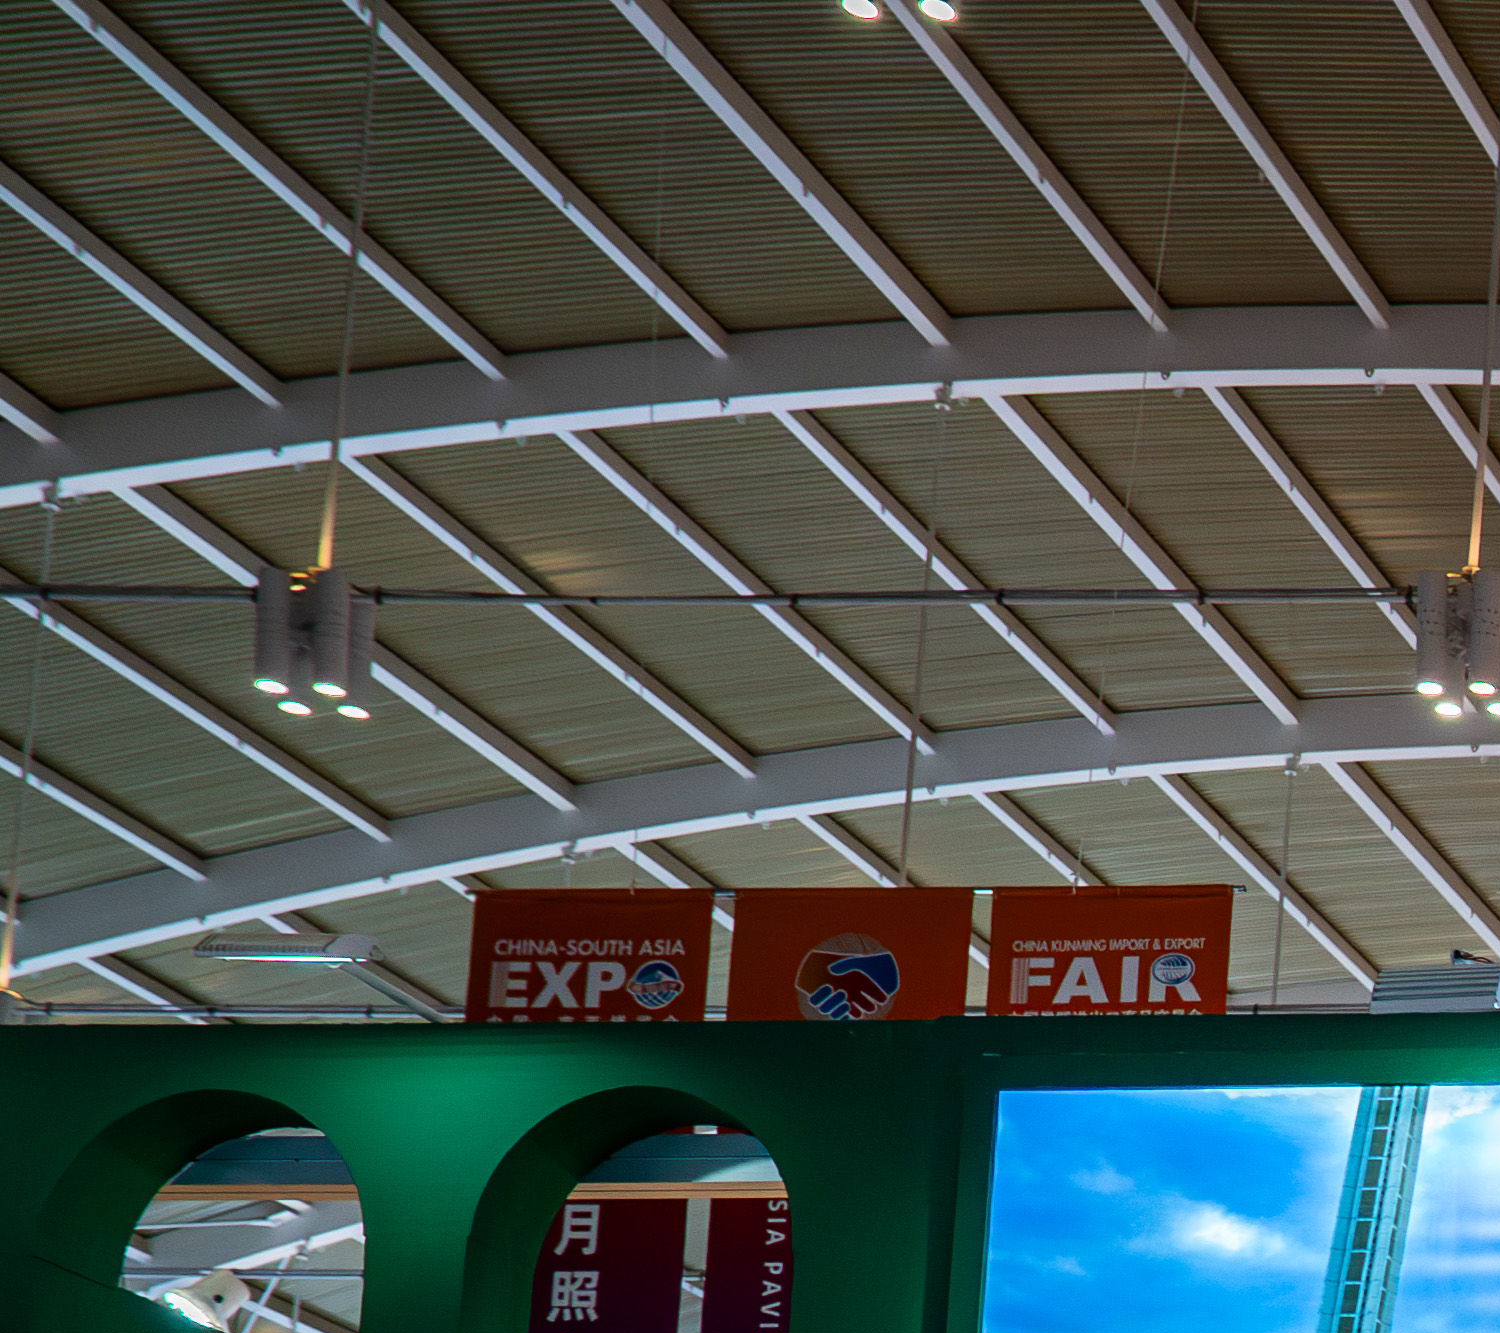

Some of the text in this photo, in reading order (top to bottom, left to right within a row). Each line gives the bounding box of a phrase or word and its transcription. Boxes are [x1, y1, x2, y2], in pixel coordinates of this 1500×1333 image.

[494, 939, 686, 956] CHINA-SOUTH ASIA
[1012, 940, 1048, 952] CHINA
[1050, 940, 1107, 952] KUNMING
[1109, 939, 1150, 951] IMPORT
[1164, 938, 1206, 950] EXPORT
[1009, 955, 1202, 1005] FAIR
